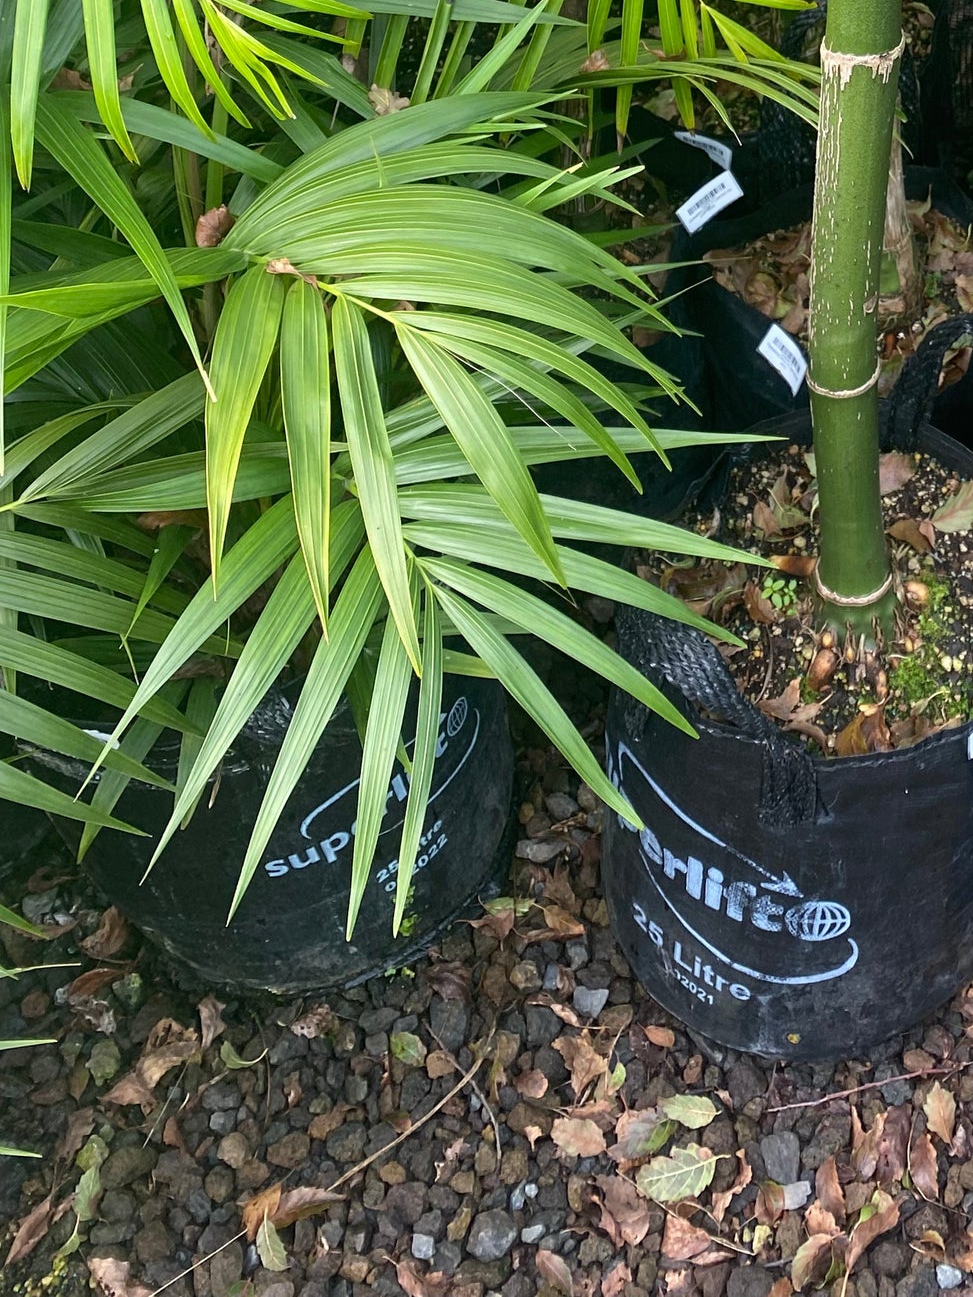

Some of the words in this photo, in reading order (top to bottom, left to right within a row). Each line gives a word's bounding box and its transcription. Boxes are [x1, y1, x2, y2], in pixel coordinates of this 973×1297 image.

[376, 859, 400, 883] 25
[384, 833, 448, 892] 02022
[632, 902, 664, 948] 25
[673, 941, 751, 1001] Litre
